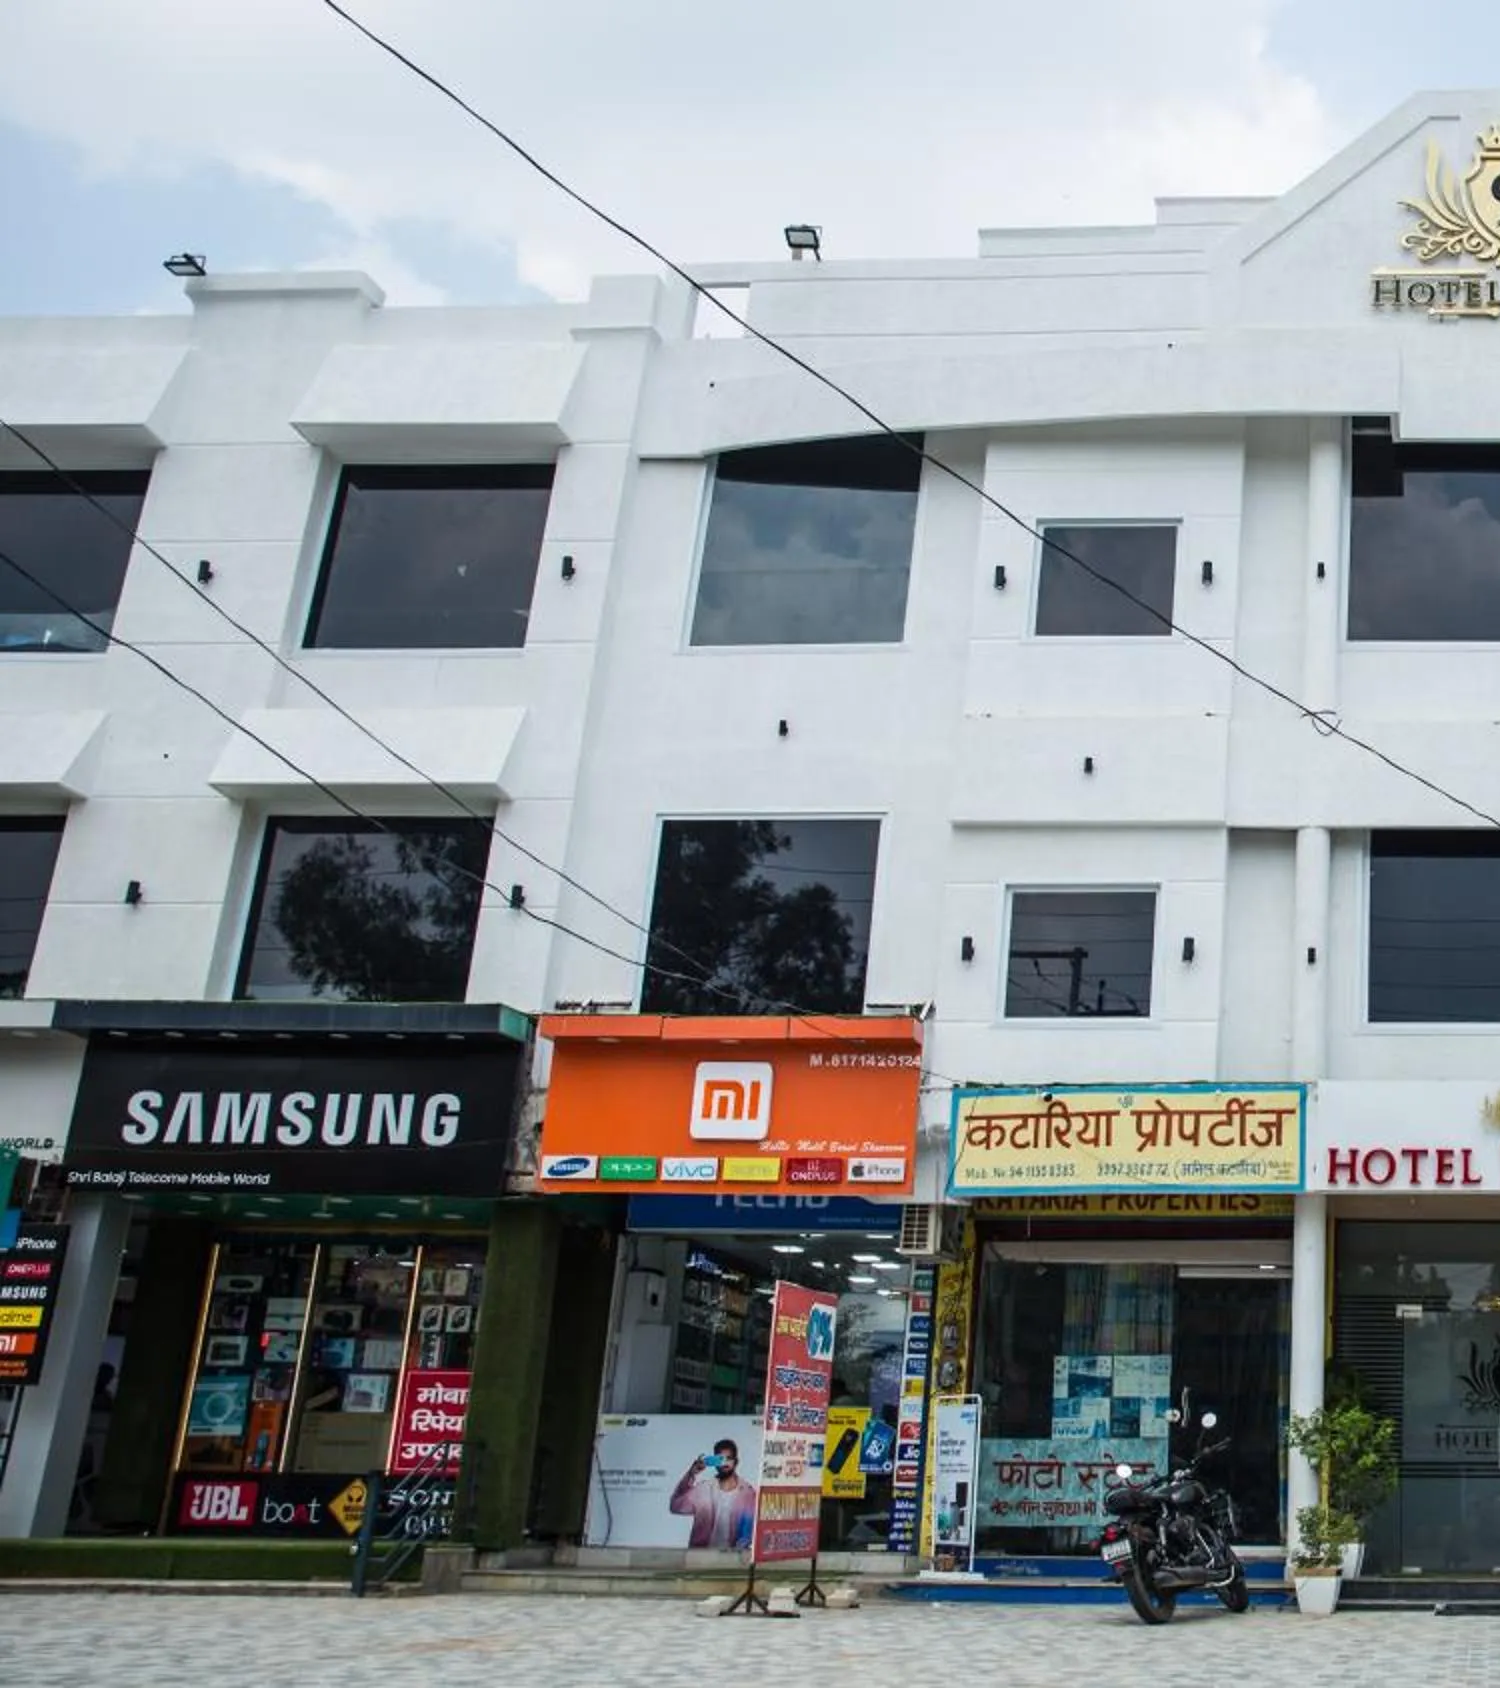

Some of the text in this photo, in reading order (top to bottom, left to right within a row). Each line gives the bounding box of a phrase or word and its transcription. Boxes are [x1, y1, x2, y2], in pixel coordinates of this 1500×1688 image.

[121, 1090, 462, 1147] SAMSUNG
[965, 1097, 1297, 1153] कटारिया प्रोपर्टीज
[233, 1172, 270, 1185] World
[867, 1164, 901, 1178] iPhone
[1327, 1147, 1482, 1185] HOTEL
[16, 1237, 57, 1249] iPhone
[992, 1453, 1066, 1489] फोटो
[190, 1485, 248, 1520] JBL
